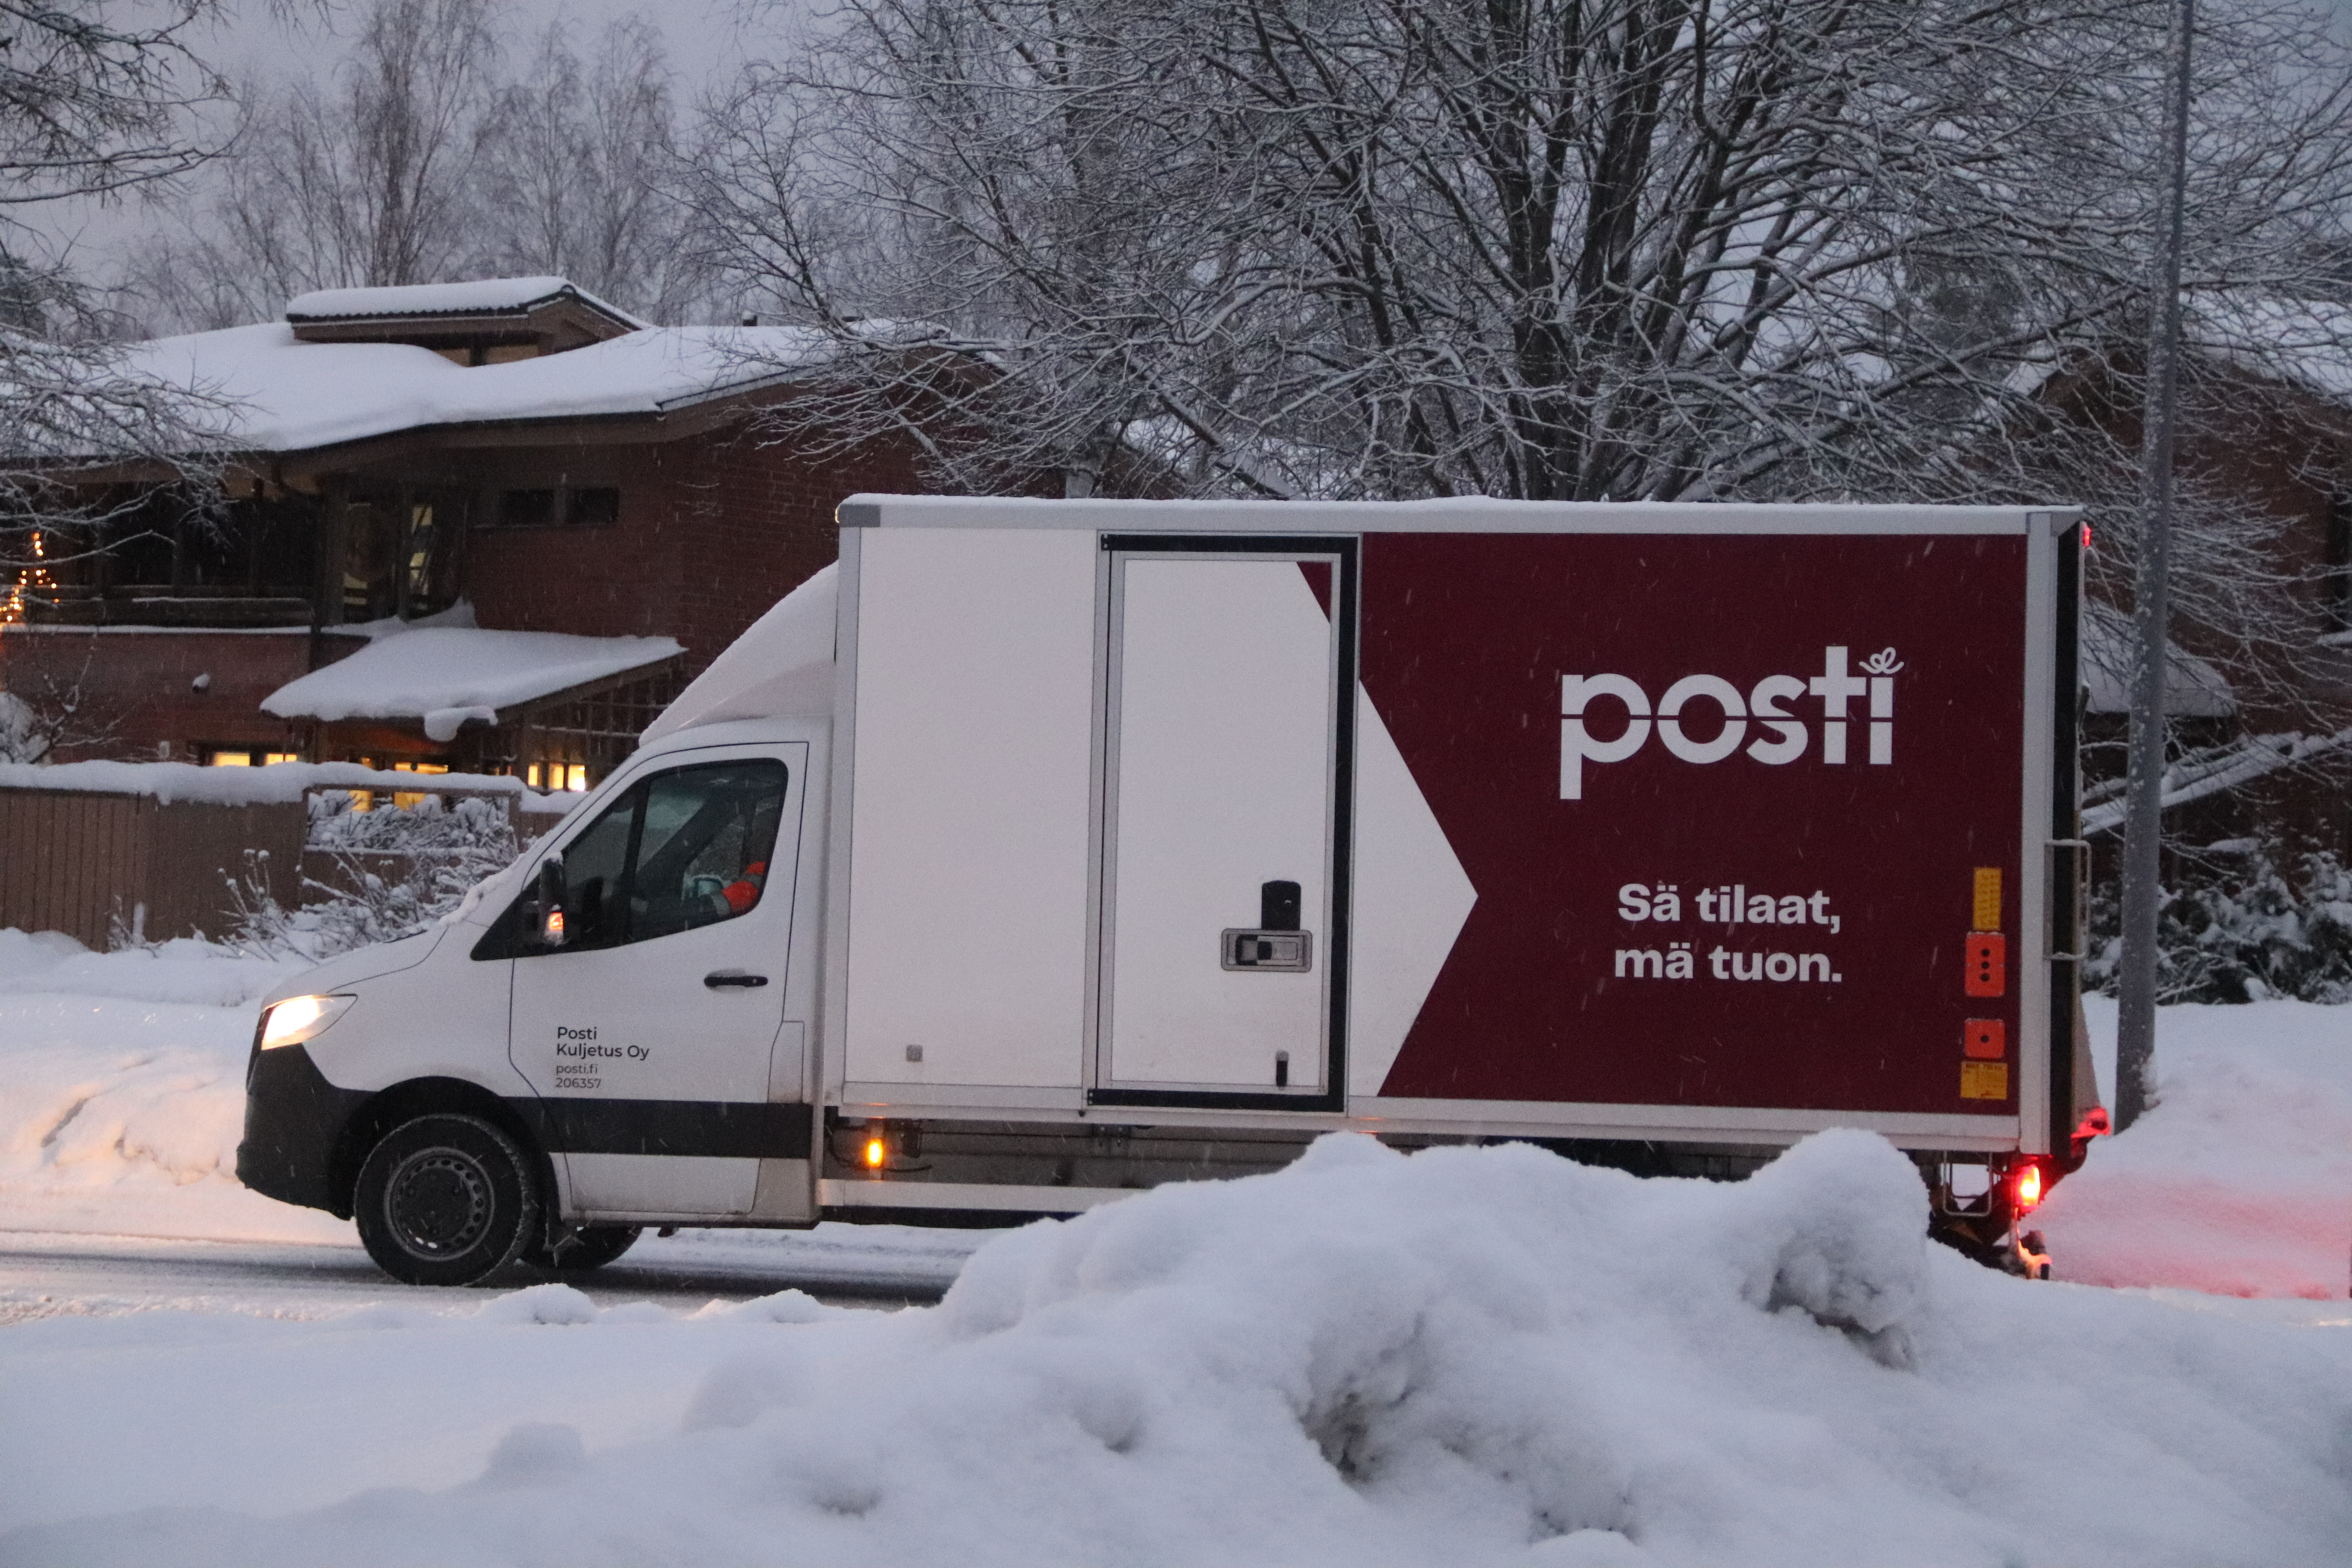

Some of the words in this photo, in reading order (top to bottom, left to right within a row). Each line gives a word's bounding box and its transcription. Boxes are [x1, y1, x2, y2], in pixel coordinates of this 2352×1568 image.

[1560, 646, 1904, 799] posti
[1618, 883, 1681, 922] Sä
[1695, 884, 1840, 934] tilaat,
[1615, 942, 1693, 979] mä
[1708, 945, 1842, 982] tuon.
[557, 1026, 597, 1040] Posti
[557, 1043, 622, 1059] Kuljetus
[627, 1045, 650, 1061] Oy
[555, 1063, 598, 1076] posti.fi
[555, 1077, 602, 1089] 206357
